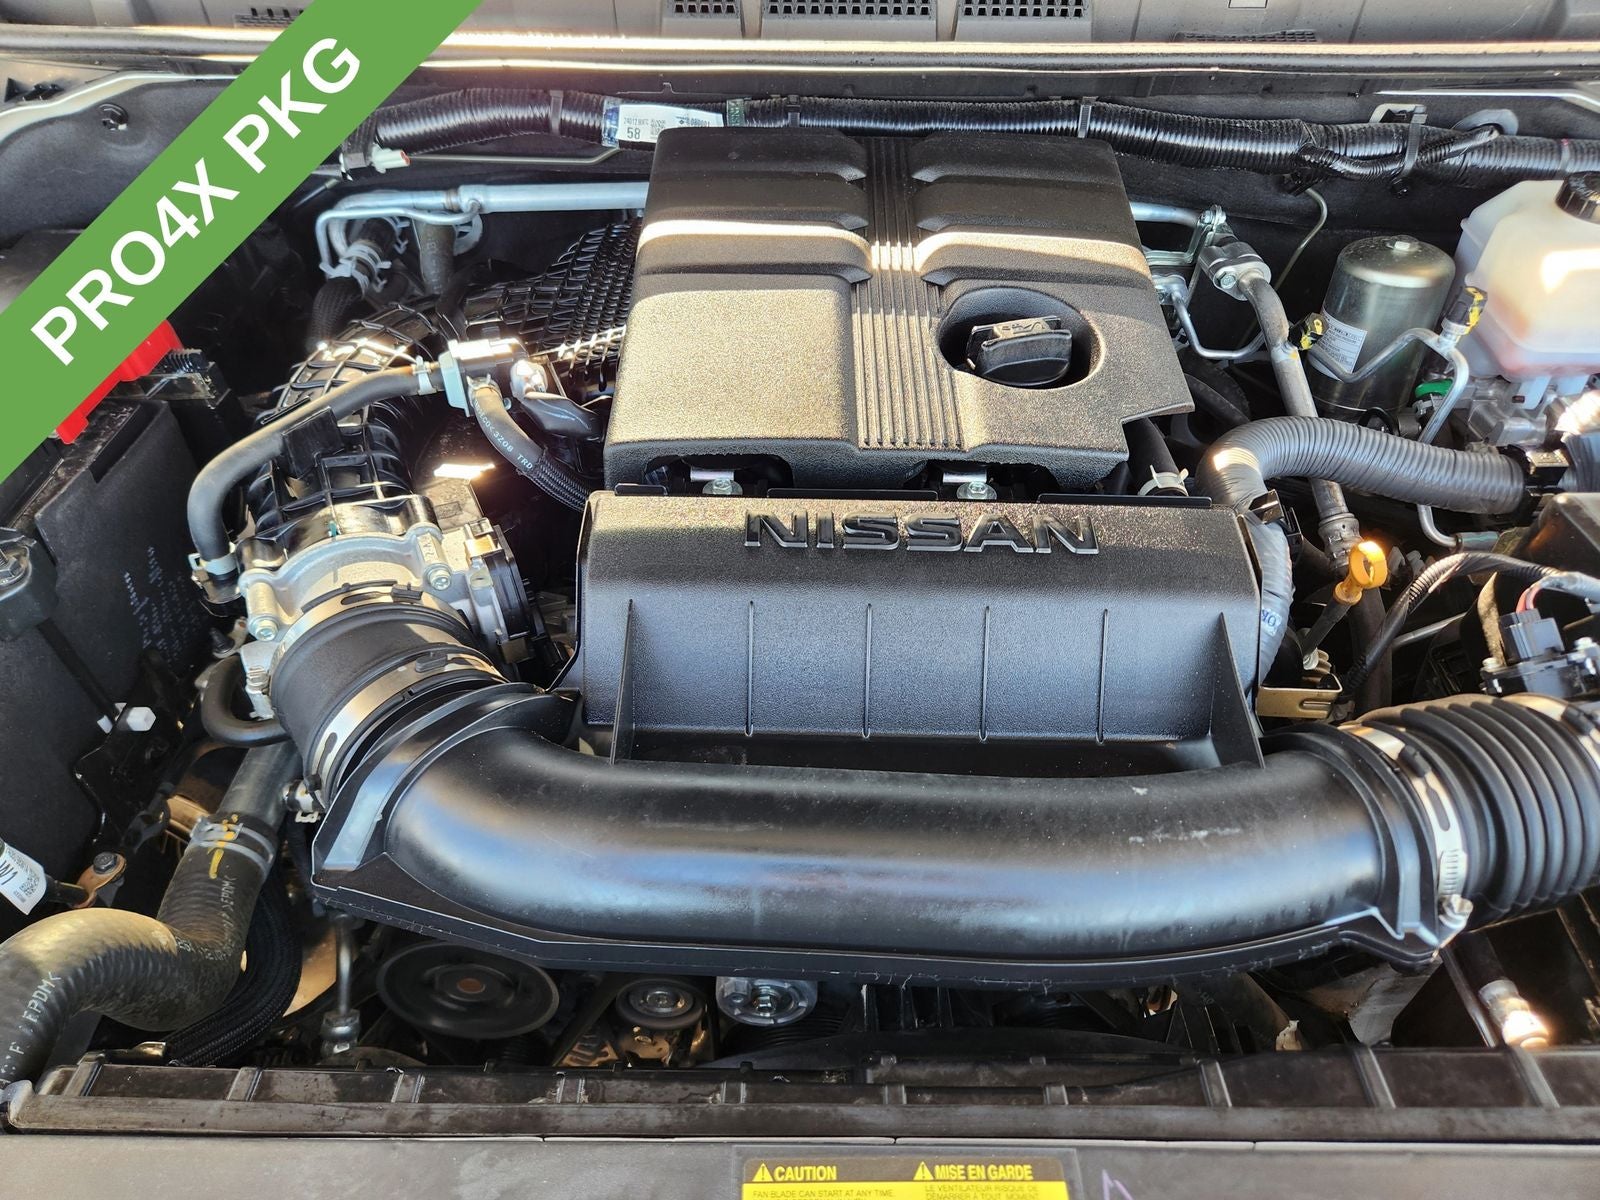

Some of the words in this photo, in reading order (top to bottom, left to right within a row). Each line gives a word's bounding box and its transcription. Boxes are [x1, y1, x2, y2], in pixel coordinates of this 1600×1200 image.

[627, 127, 641, 140] 58
[517, 453, 533, 469] TRD
[744, 508, 1100, 555] NISSAN
[773, 1165, 838, 1182] CAUTION
[934, 1164, 966, 1181] MISE
[967, 1164, 986, 1181] EN
[987, 1164, 1033, 1180] GARDE
[753, 1190, 769, 1199] FAN
[770, 1190, 797, 1198] BLADE
[799, 1190, 816, 1198] CAN
[818, 1189, 843, 1198] START
